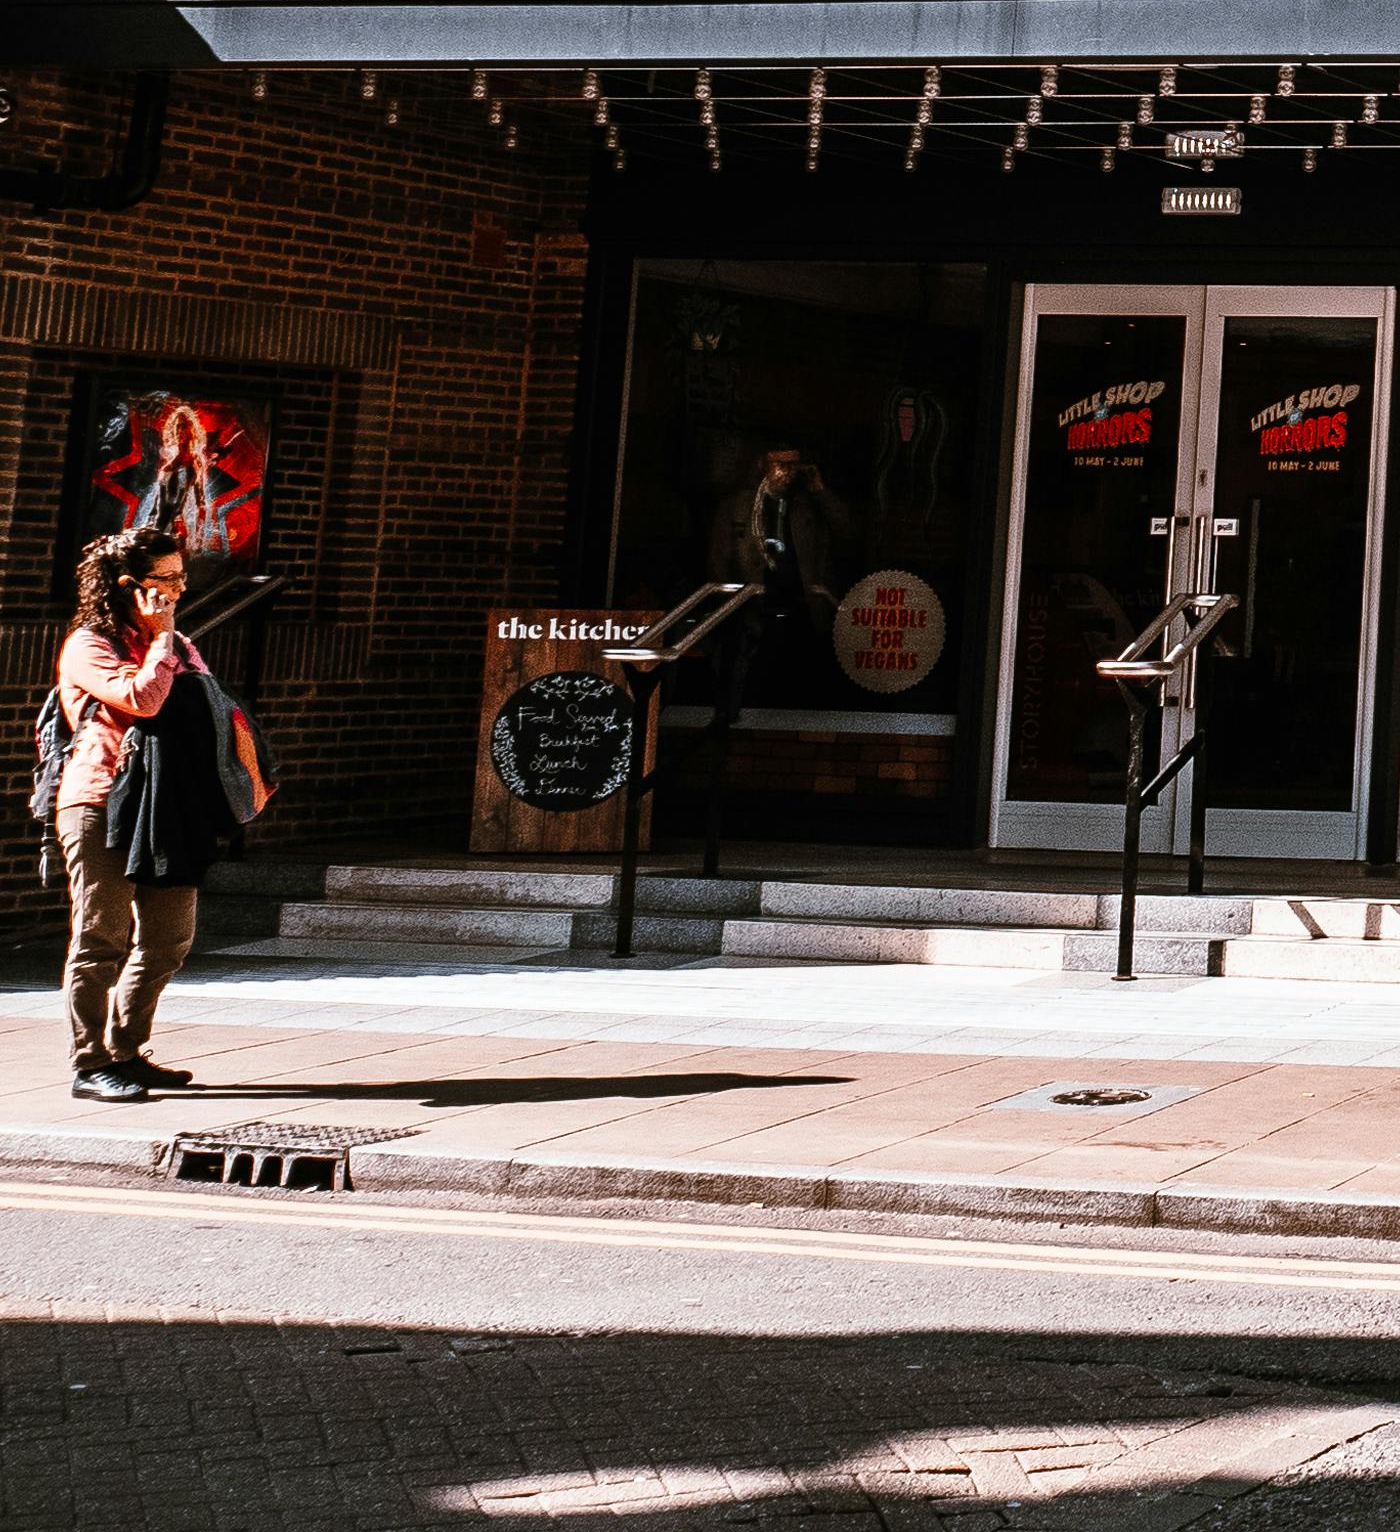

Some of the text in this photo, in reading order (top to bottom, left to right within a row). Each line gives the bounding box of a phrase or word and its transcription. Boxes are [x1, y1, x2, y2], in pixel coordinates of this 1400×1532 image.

[1058, 381, 1166, 428] LITTLE SHOP
[1251, 384, 1360, 432] LITTLE SHOP
[876, 587, 906, 606] NOT
[497, 617, 542, 639] the
[852, 608, 927, 628] SUITABLE
[872, 630, 904, 648] FOR
[855, 651, 918, 670] VEGANS
